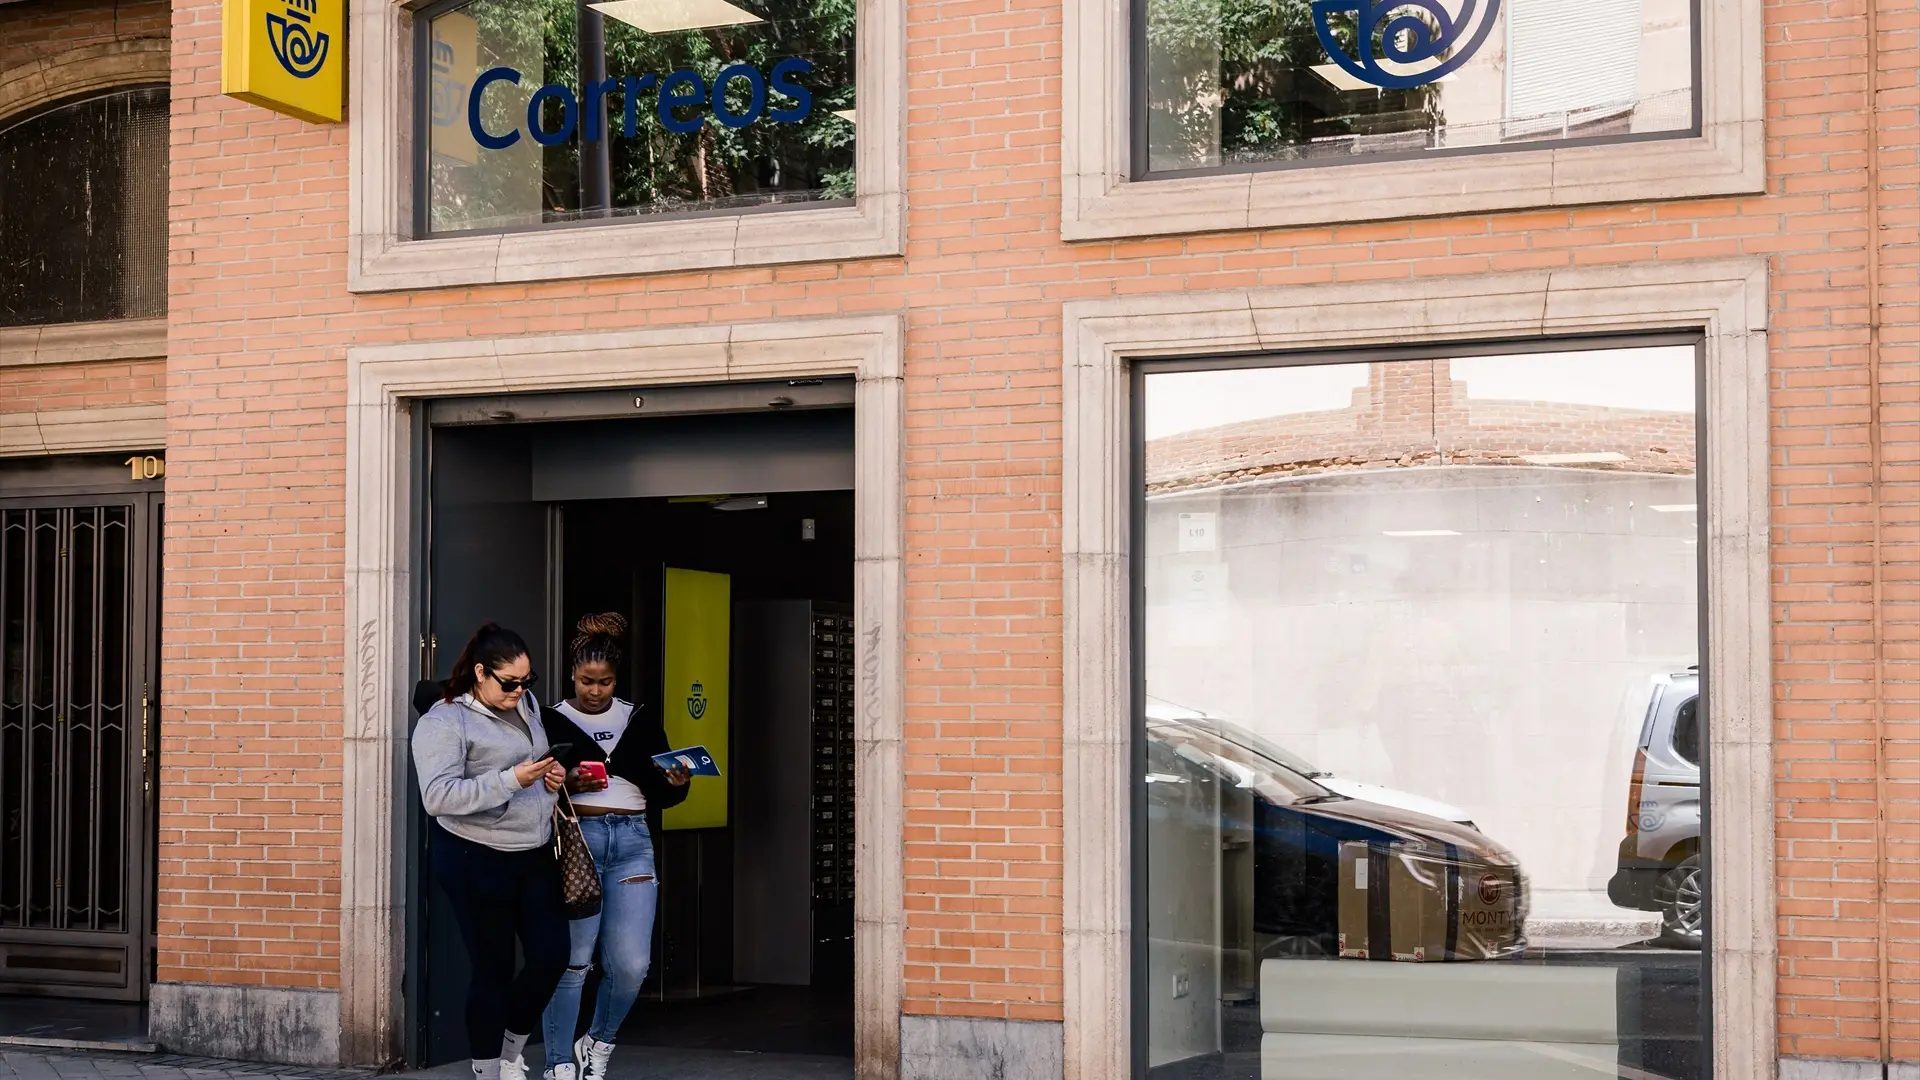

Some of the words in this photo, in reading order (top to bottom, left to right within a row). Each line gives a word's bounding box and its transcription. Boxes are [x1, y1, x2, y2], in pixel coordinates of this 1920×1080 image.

[468, 57, 812, 149] Correos
[124, 455, 164, 480] 10
[593, 731, 614, 741] DG
[1462, 910, 1514, 926] MONTY
